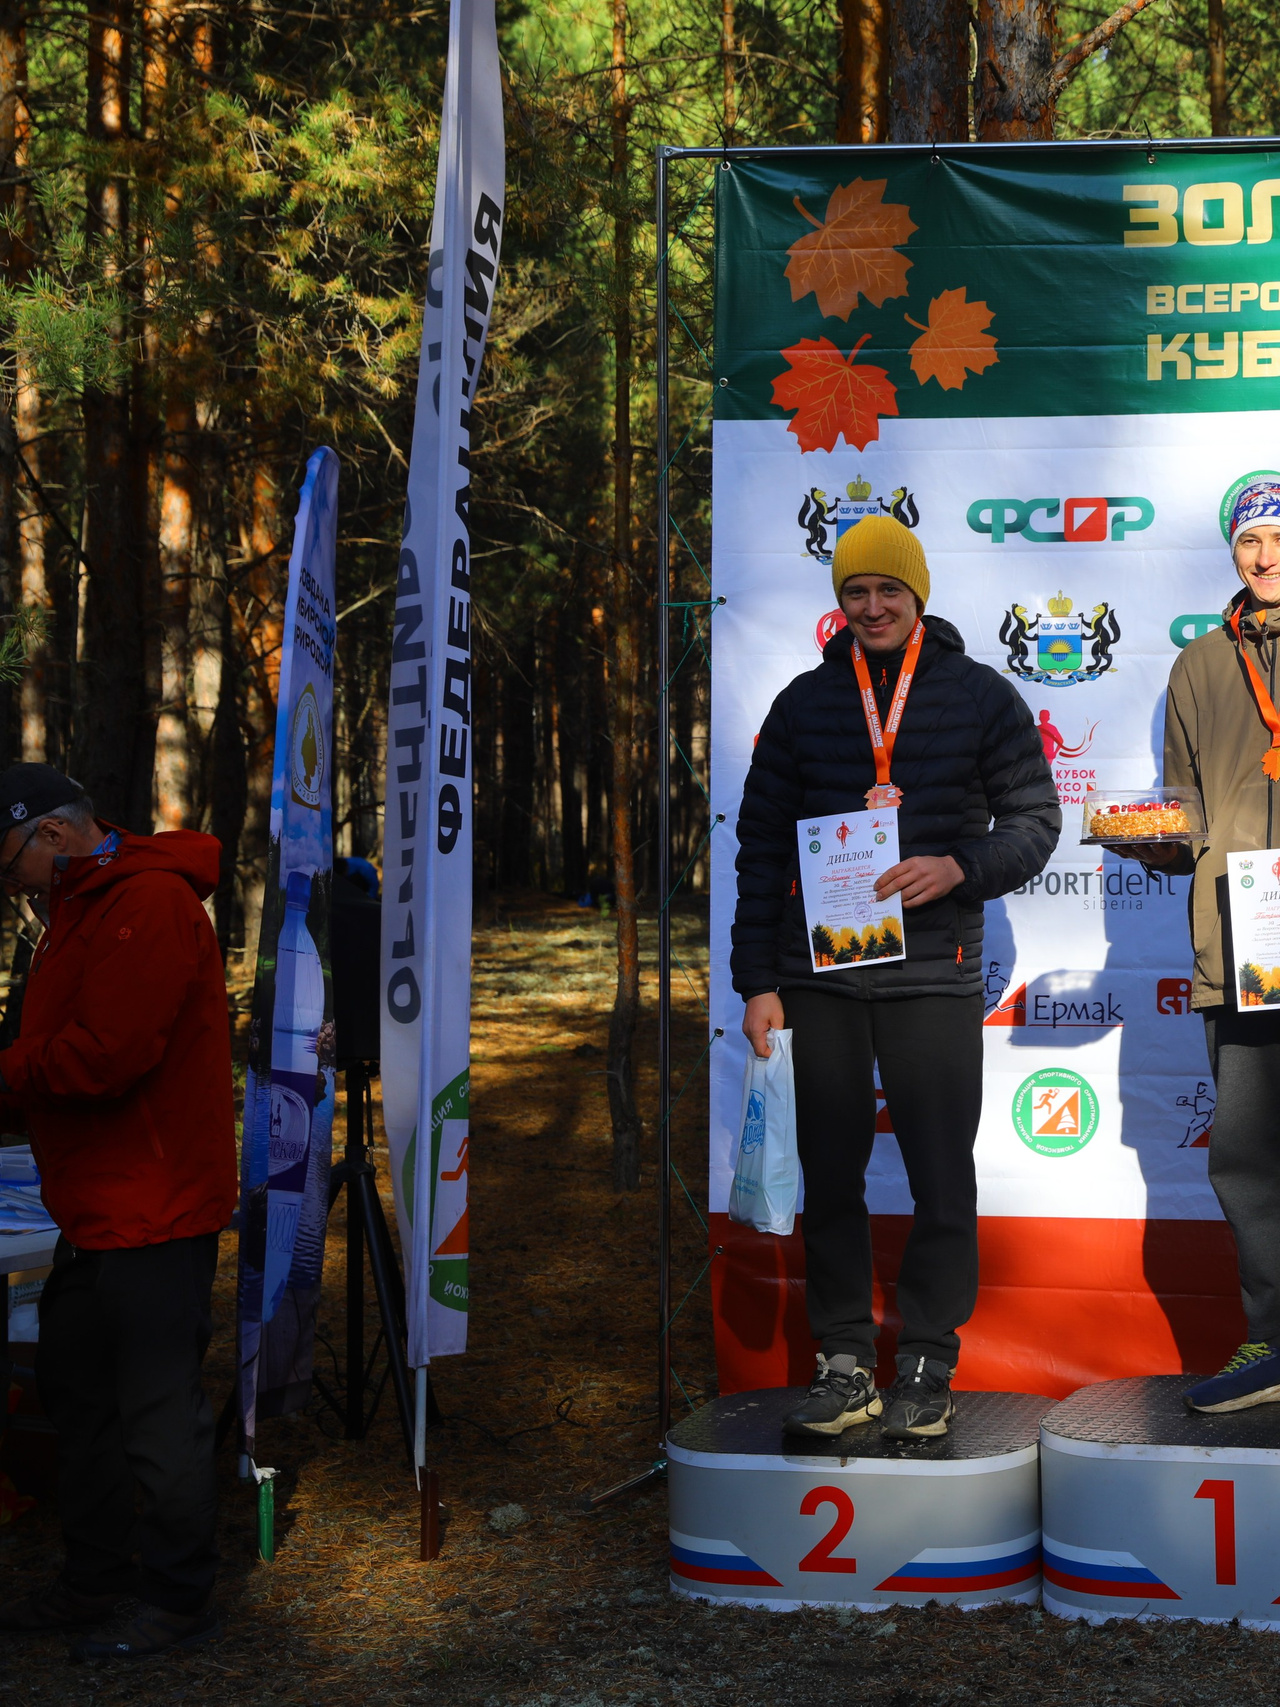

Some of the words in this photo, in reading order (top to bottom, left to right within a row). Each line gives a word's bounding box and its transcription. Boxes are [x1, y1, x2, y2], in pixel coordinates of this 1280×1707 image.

[891, 699, 905, 734] ЗОЛОТАЯ
[900, 673, 912, 698] ОСЕНЬ
[1056, 769, 1097, 779] КУБОК
[1056, 782, 1082, 792] КСО
[826, 850, 874, 866] ДИПЛОМ
[1083, 897, 1143, 911] siberia
[1034, 993, 1124, 1028] Ермак
[1038, 1071, 1082, 1086] СПОРТИВНОГО
[798, 1485, 857, 1574] 2
[1194, 1479, 1237, 1585] 1
